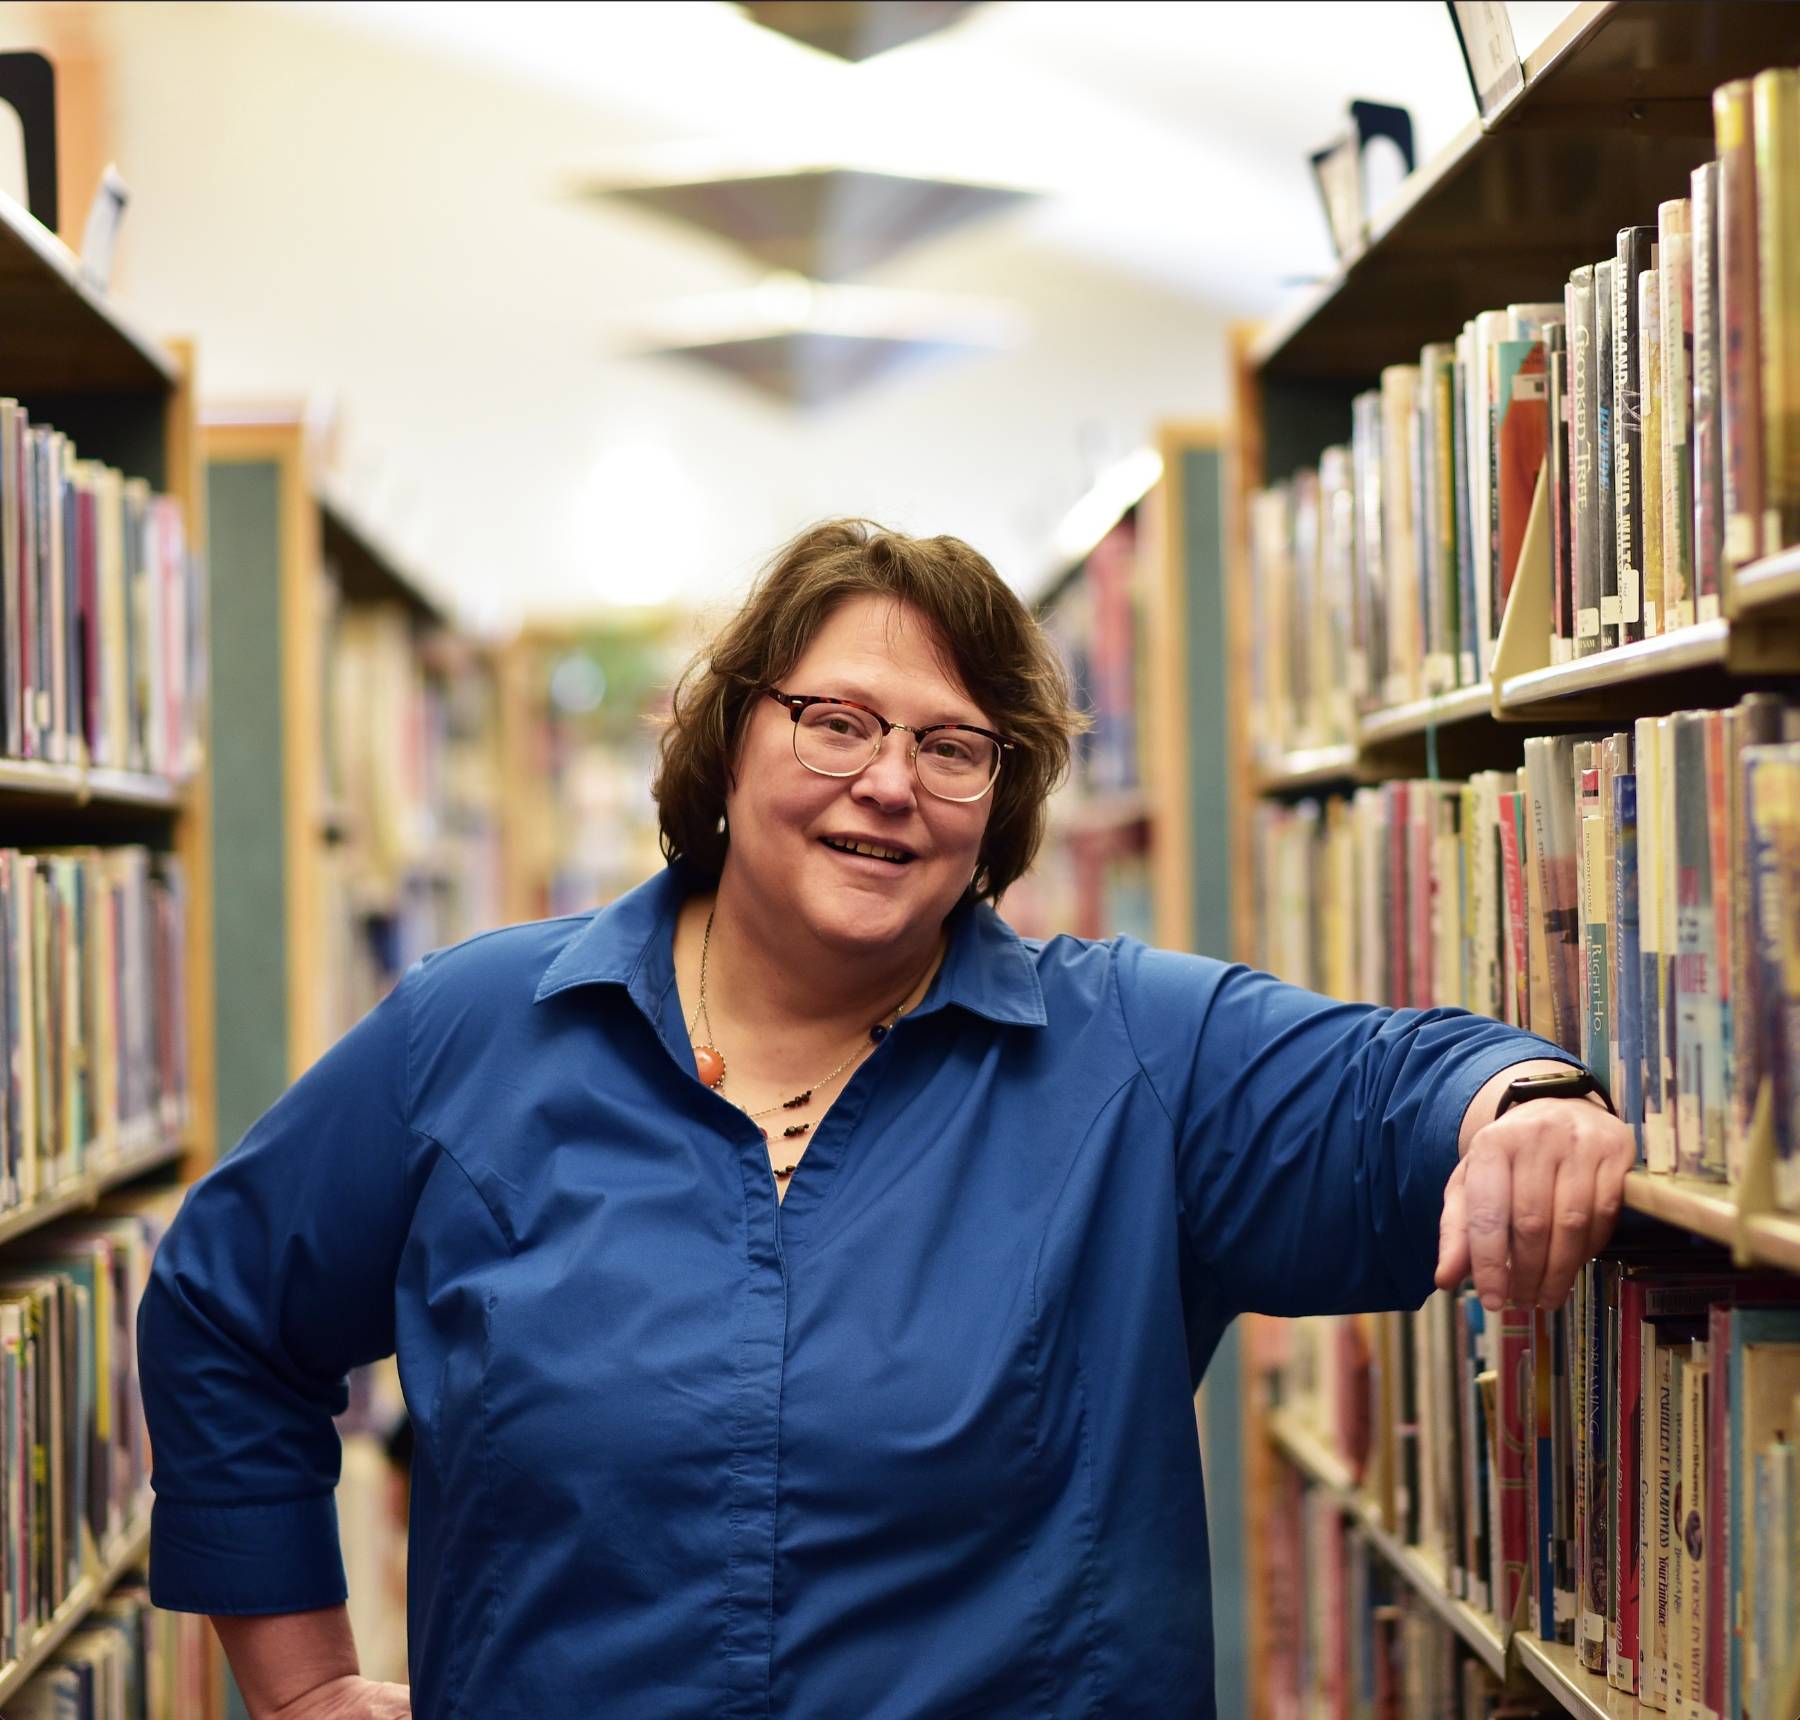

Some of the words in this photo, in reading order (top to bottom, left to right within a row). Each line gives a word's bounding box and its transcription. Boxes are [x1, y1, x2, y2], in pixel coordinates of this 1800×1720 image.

[1618, 262, 1628, 385] HEARTLAND
[1574, 325, 1590, 440] CROOKED
[1576, 441, 1592, 513] TREE
[1621, 443, 1631, 506] DAVID
[1534, 799, 1544, 834] dirt
[1538, 841, 1549, 905] music
[1592, 943, 1603, 996] RIGHT
[1660, 1386, 1670, 1452] KATHLEEN
[1660, 1469, 1670, 1548] WOODIWISS
